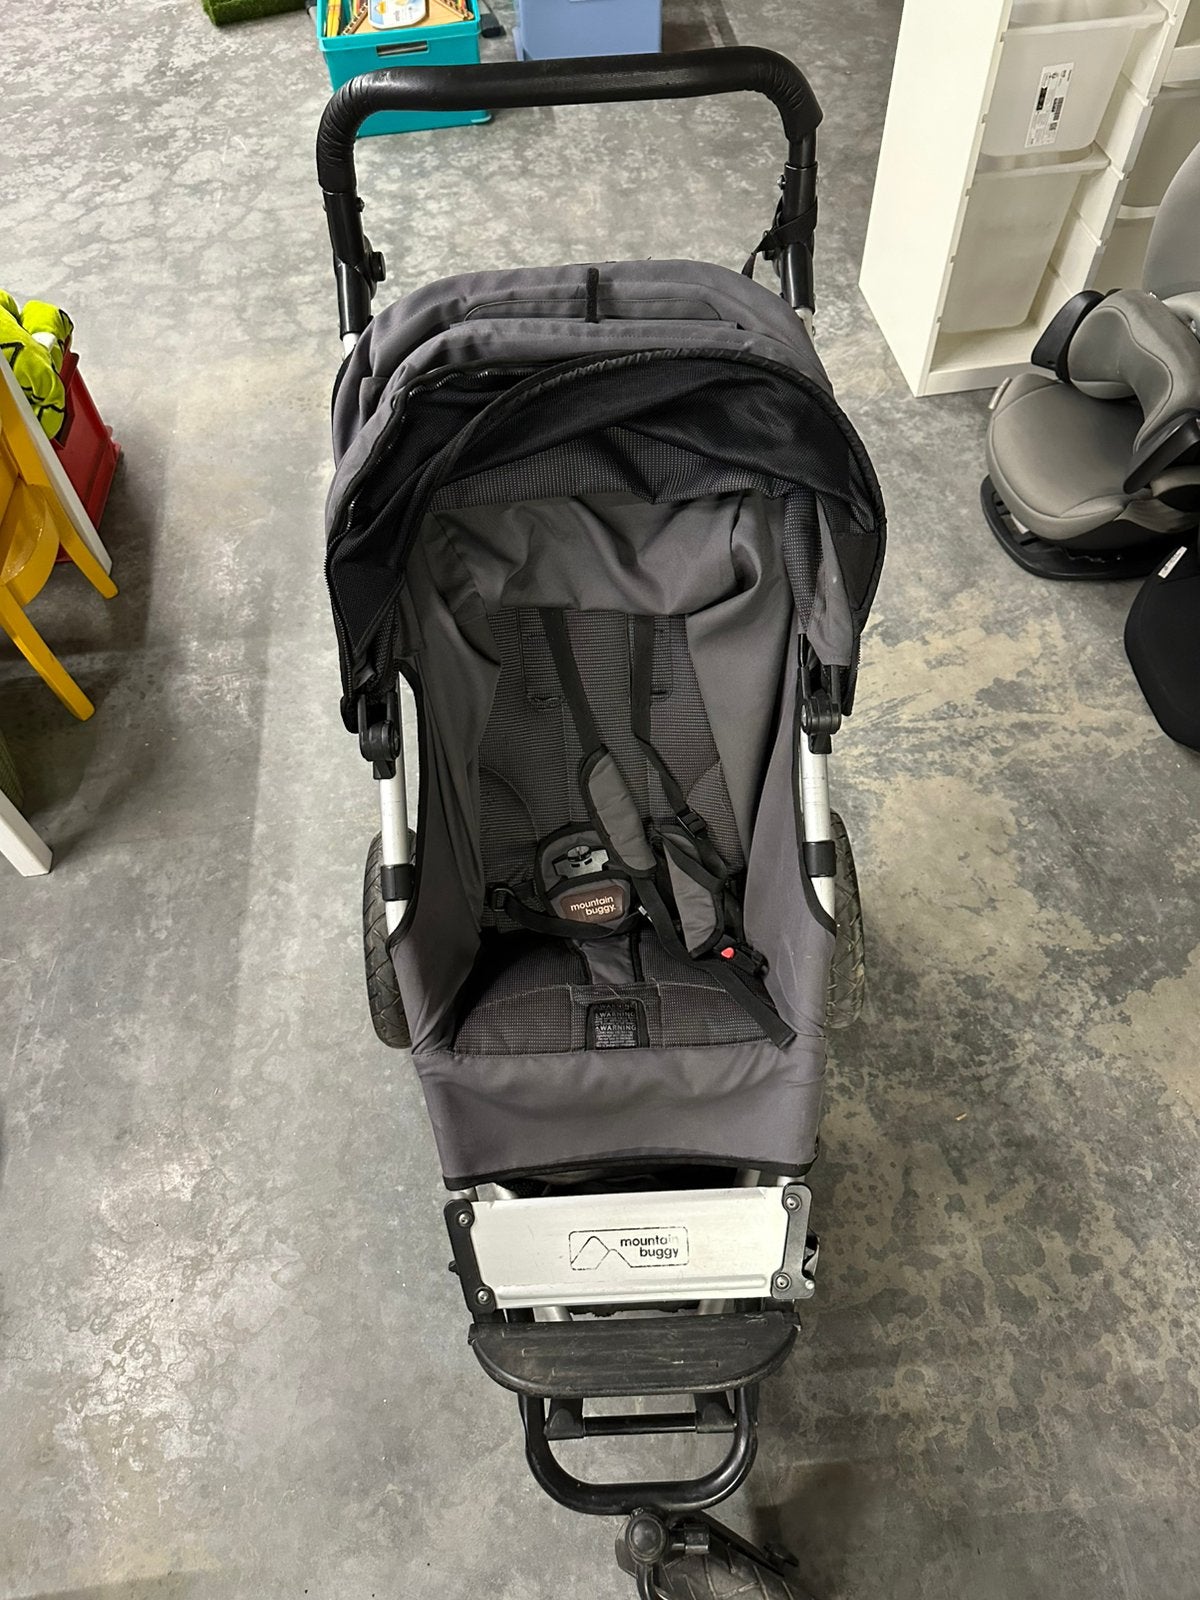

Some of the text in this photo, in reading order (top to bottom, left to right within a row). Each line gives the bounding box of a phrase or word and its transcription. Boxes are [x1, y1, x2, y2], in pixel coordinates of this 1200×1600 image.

[570, 896, 614, 912] mountain
[620, 1233, 679, 1247] mountain
[639, 1246, 679, 1260] buggy
